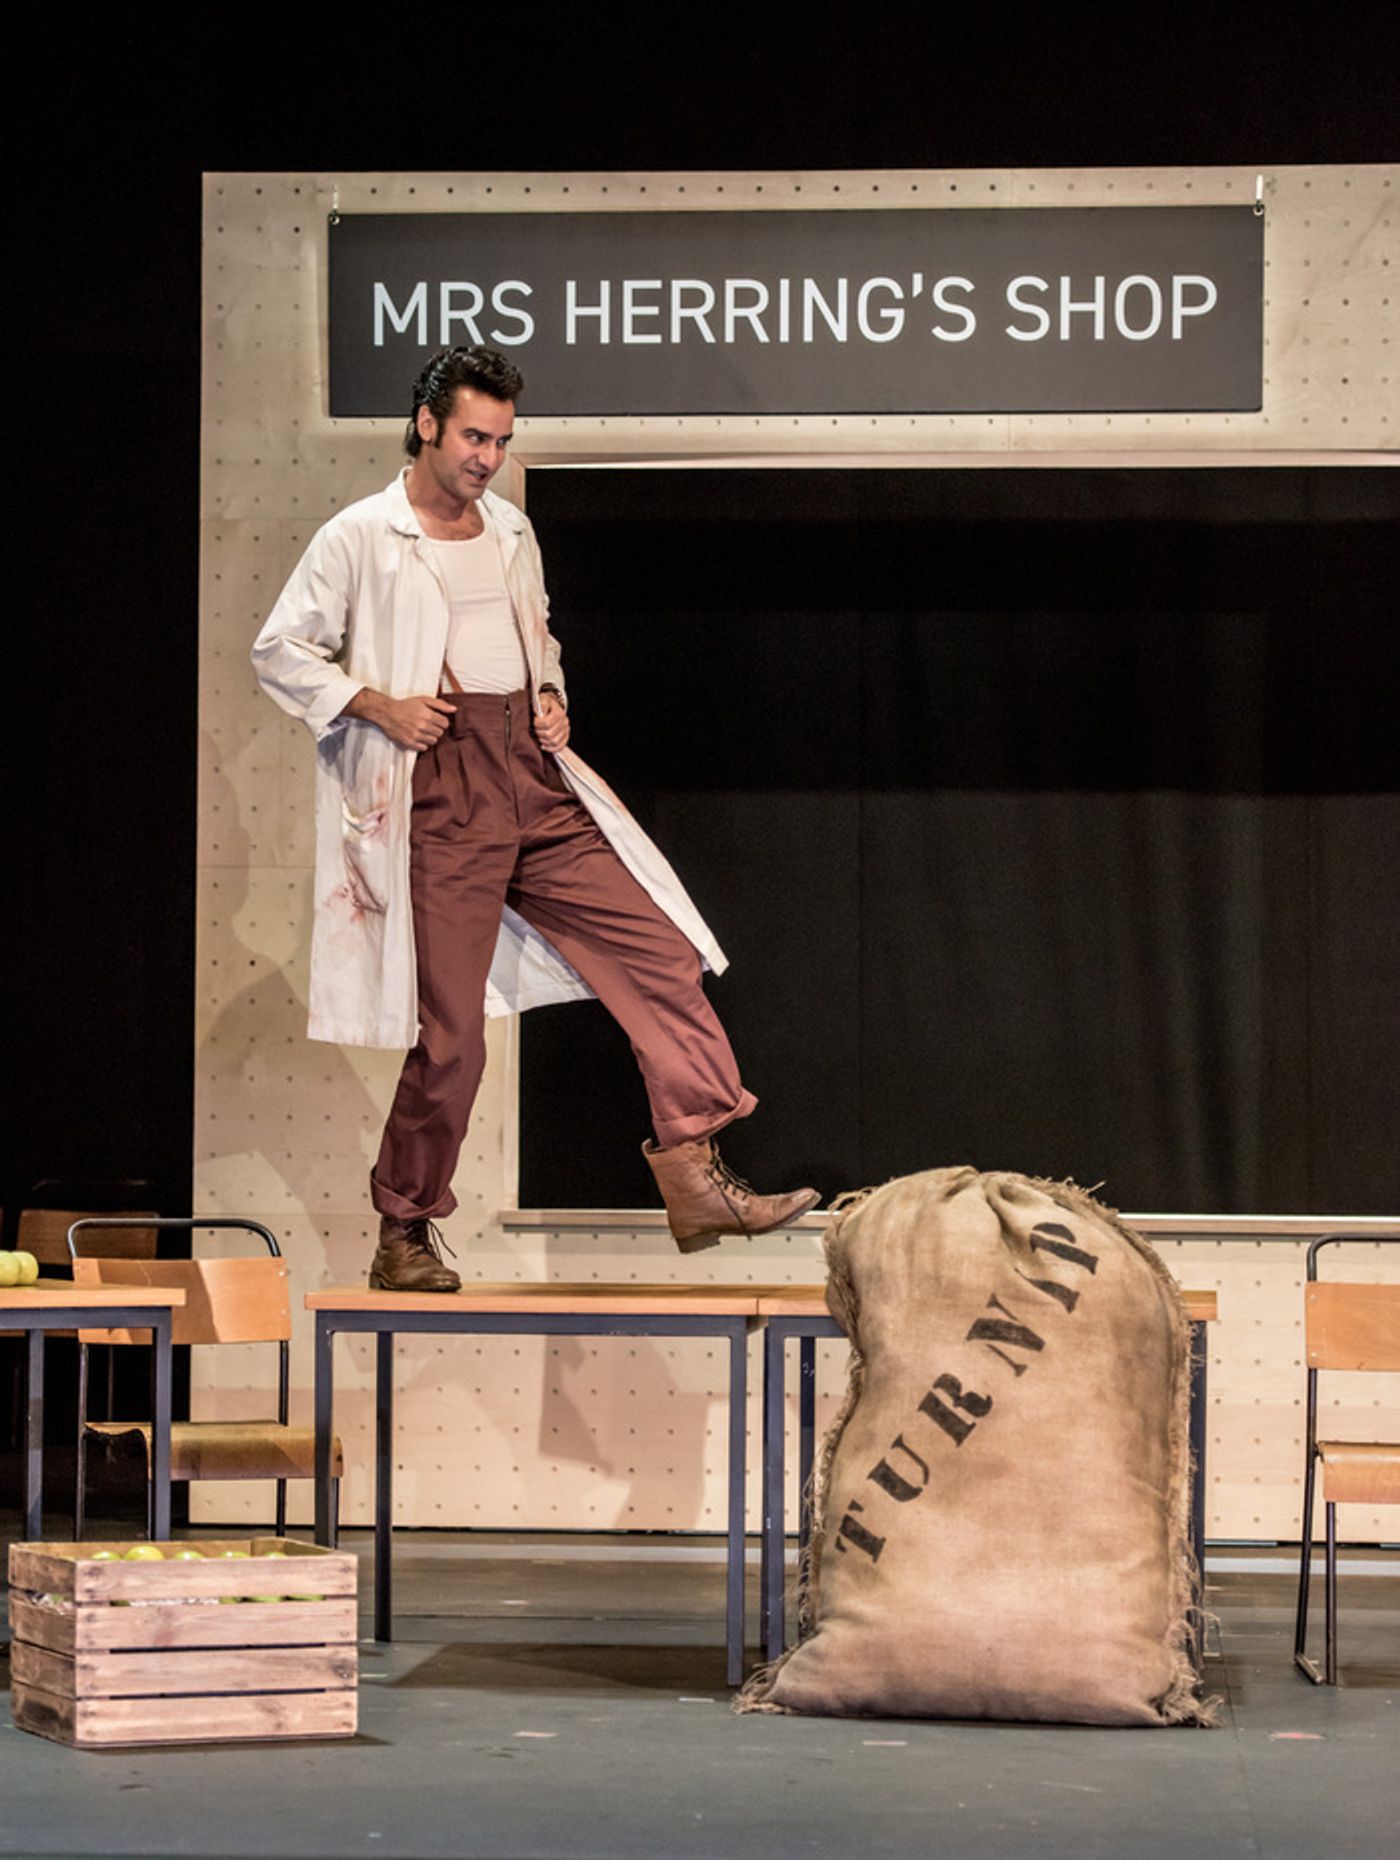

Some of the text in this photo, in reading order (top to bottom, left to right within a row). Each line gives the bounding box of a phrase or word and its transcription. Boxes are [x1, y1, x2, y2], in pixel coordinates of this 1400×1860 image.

[373, 272, 1220, 346] MRS HERRING'S SHOP
[834, 1221, 1100, 1563] TURNIP
